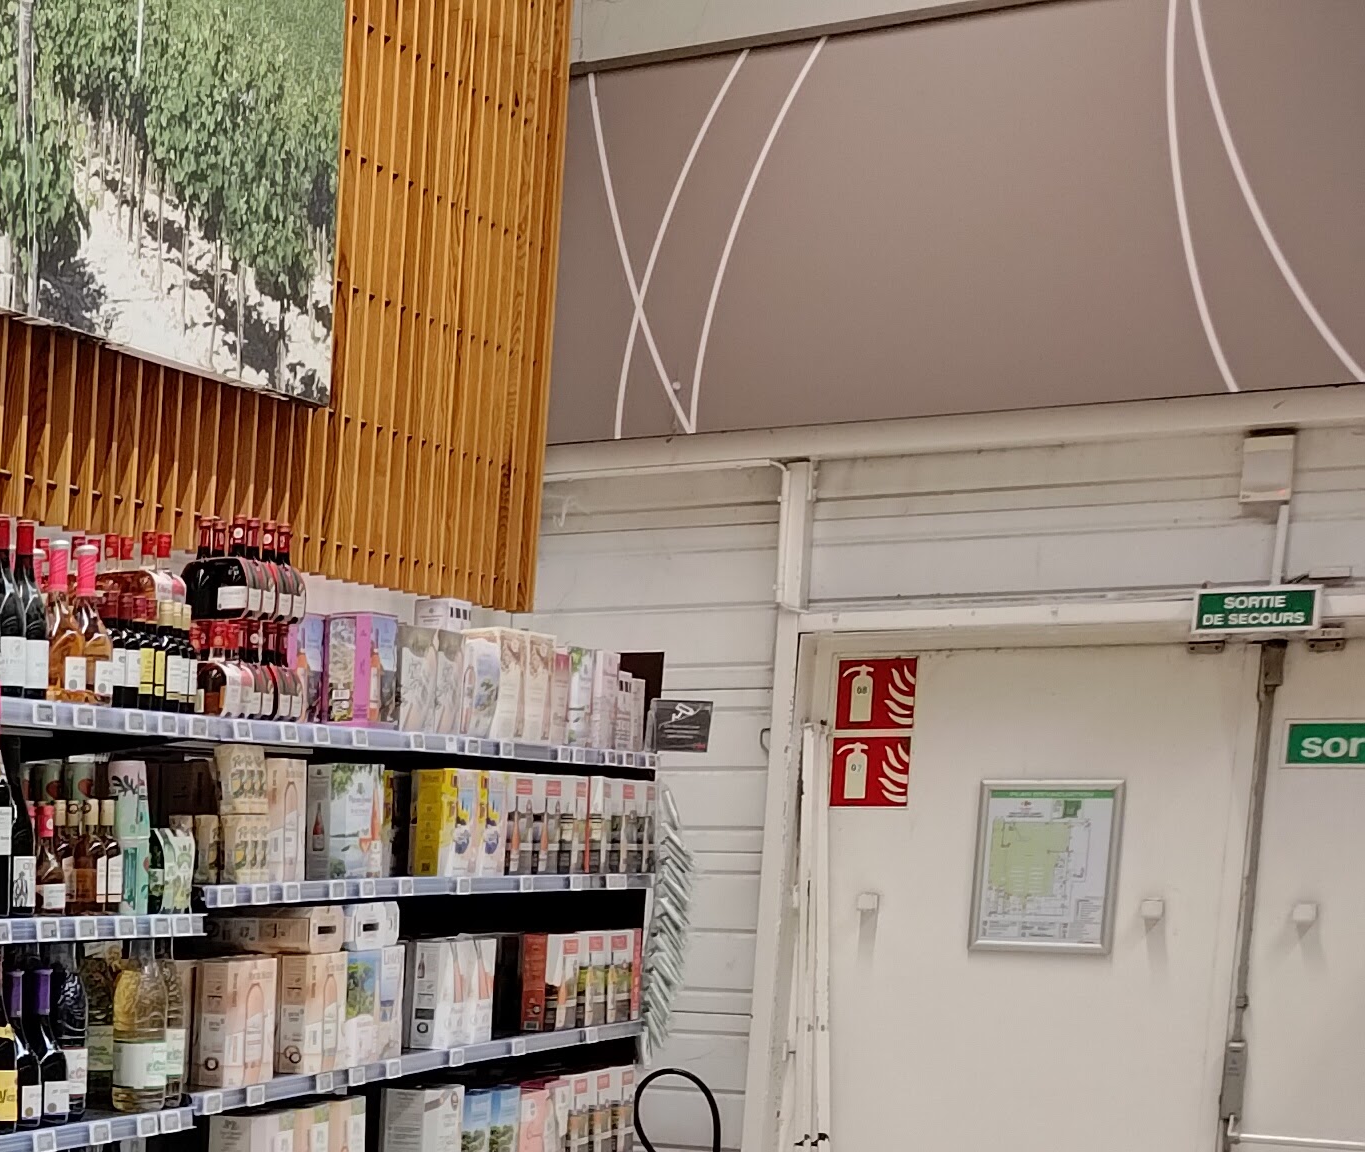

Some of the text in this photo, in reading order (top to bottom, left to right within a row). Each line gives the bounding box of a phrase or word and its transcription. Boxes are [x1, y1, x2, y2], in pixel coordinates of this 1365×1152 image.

[1223, 595, 1287, 611] SORTIE
[1202, 611, 1306, 628] DE SECOURS
